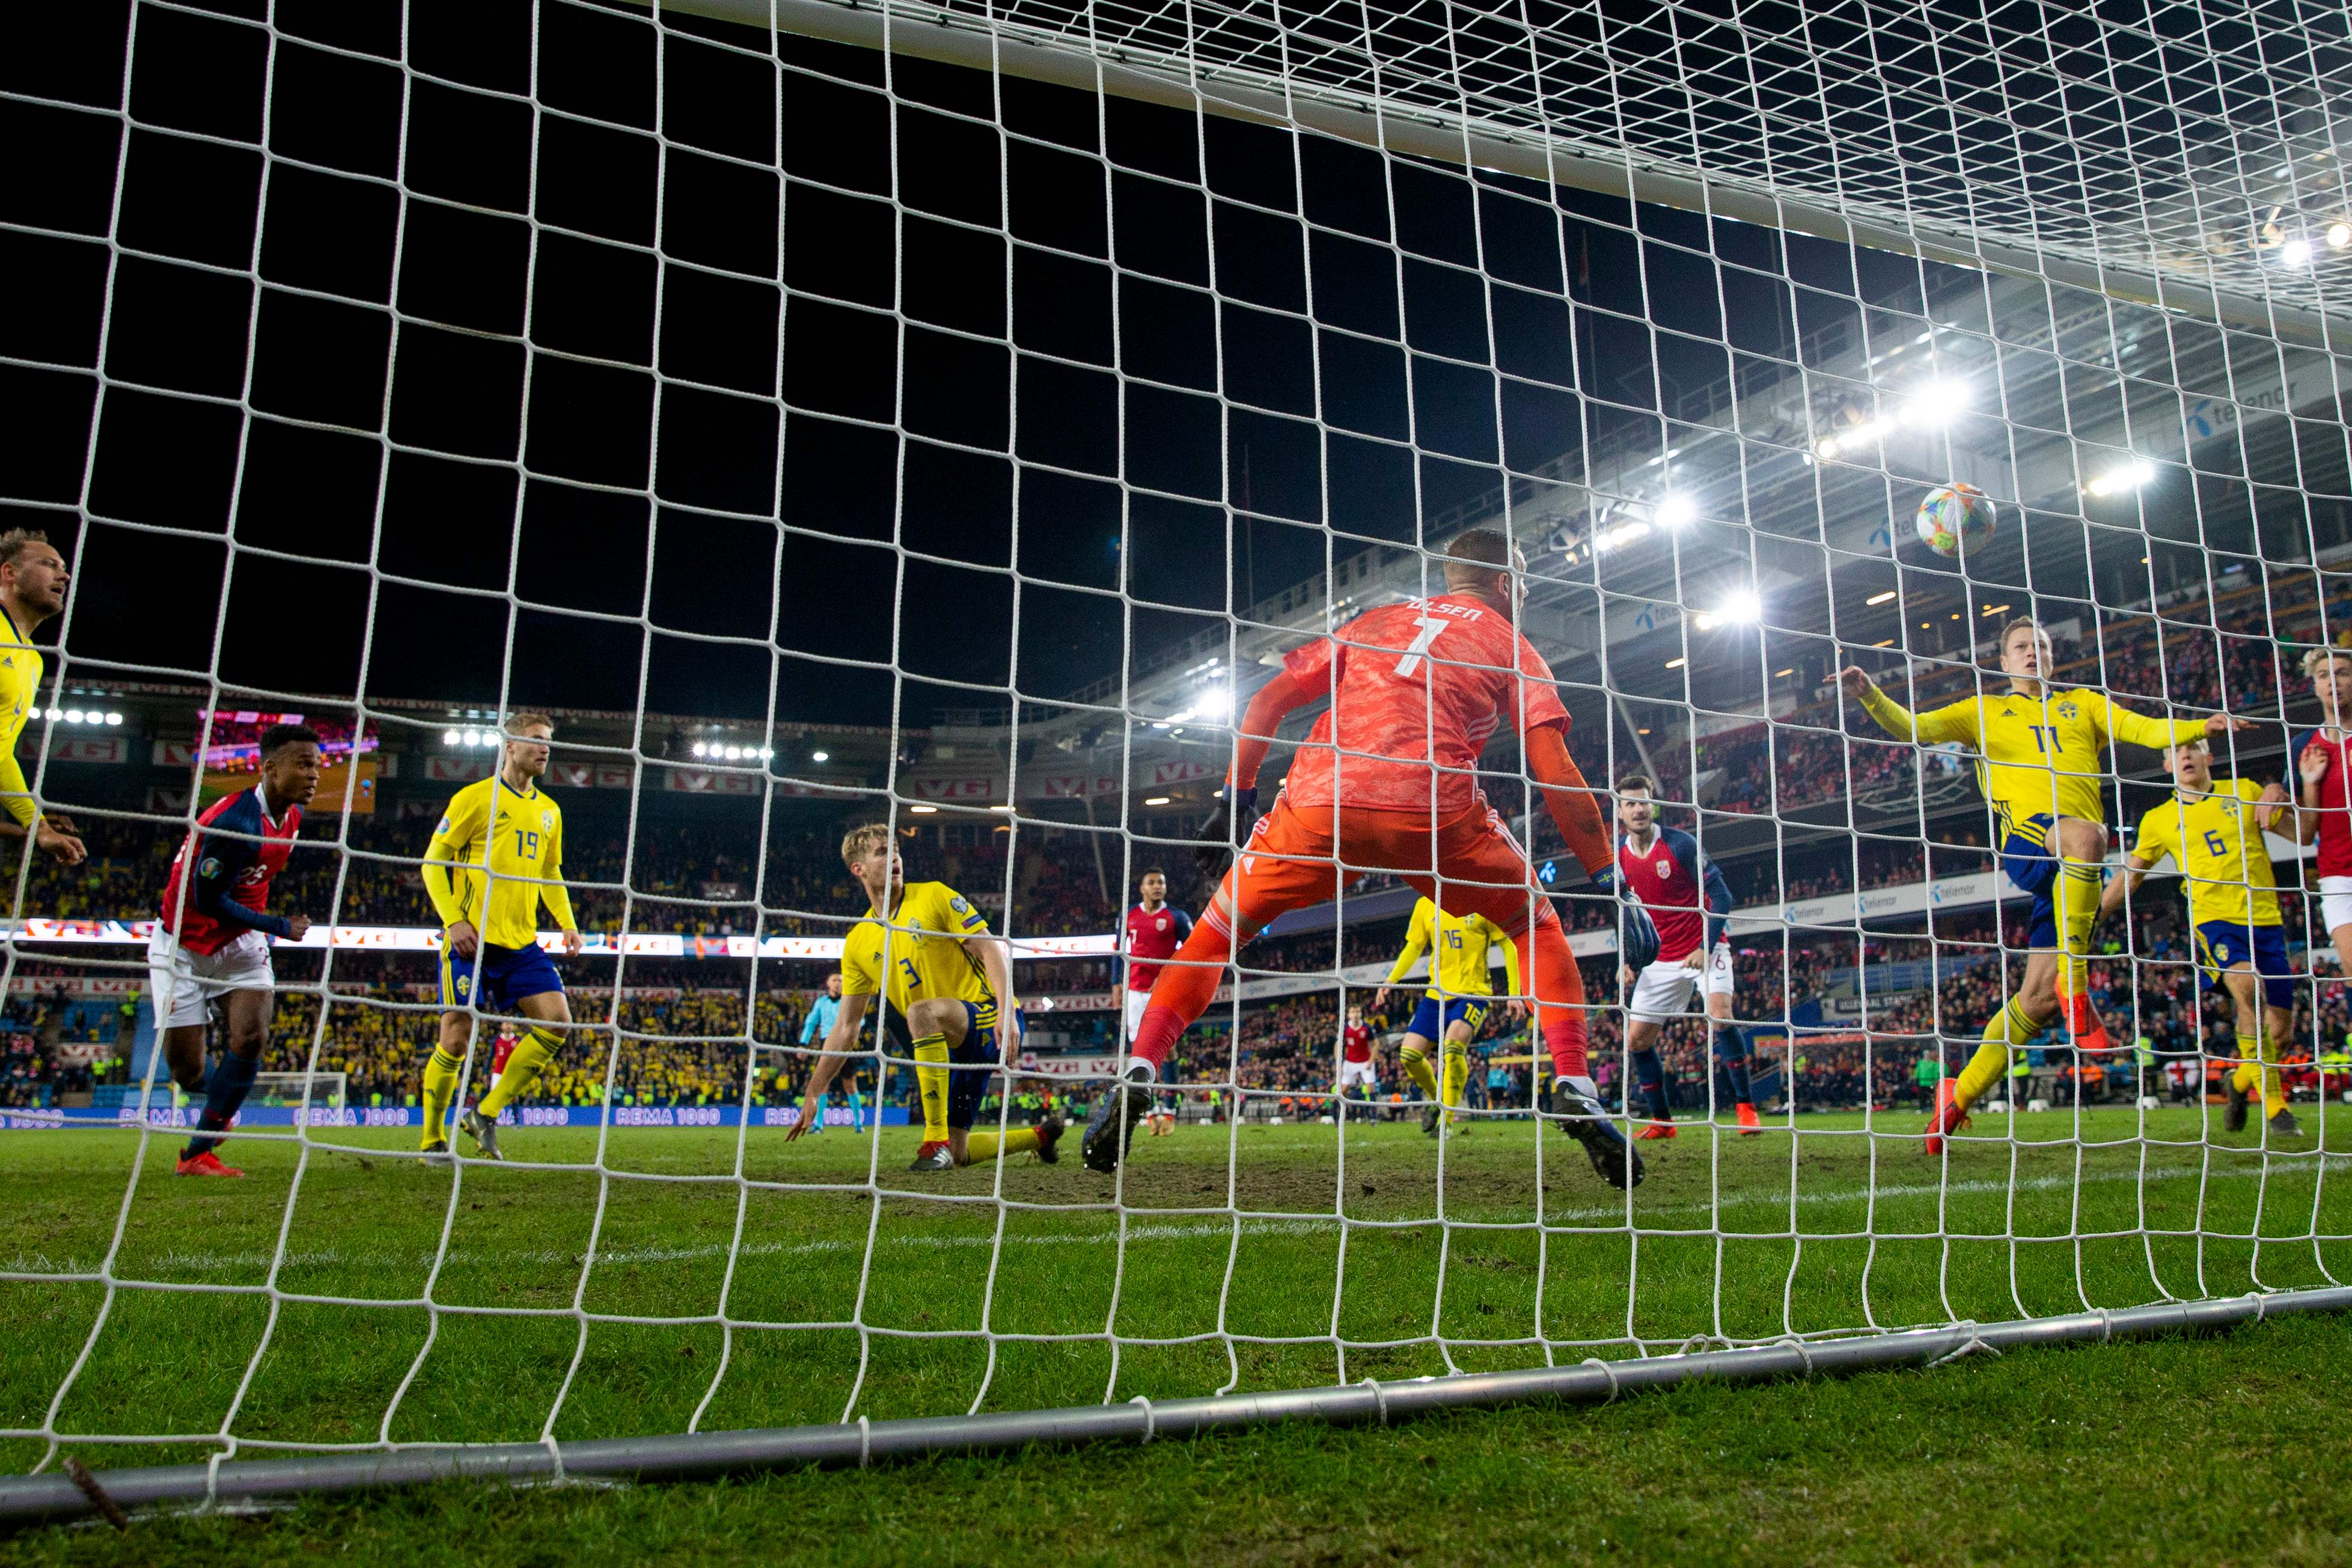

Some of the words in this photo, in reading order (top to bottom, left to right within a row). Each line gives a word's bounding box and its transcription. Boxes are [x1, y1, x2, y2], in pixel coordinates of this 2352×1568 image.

[2214, 381, 2297, 426] teenor
[1407, 600, 1483, 621] OLSEN
[2028, 725, 2063, 753] 11
[515, 829, 539, 860] 19
[2204, 829, 2227, 856] 6
[1444, 929, 1462, 949] 16
[1715, 953, 1726, 971] 6
[899, 957, 922, 989] 3
[1464, 1002, 1481, 1027] 16
[118, 1108, 188, 1127] RMA
[360, 1108, 409, 1126] 1000
[522, 1107, 569, 1126] 1000
[614, 1107, 673, 1126] REMA
[676, 1108, 721, 1126] 1000
